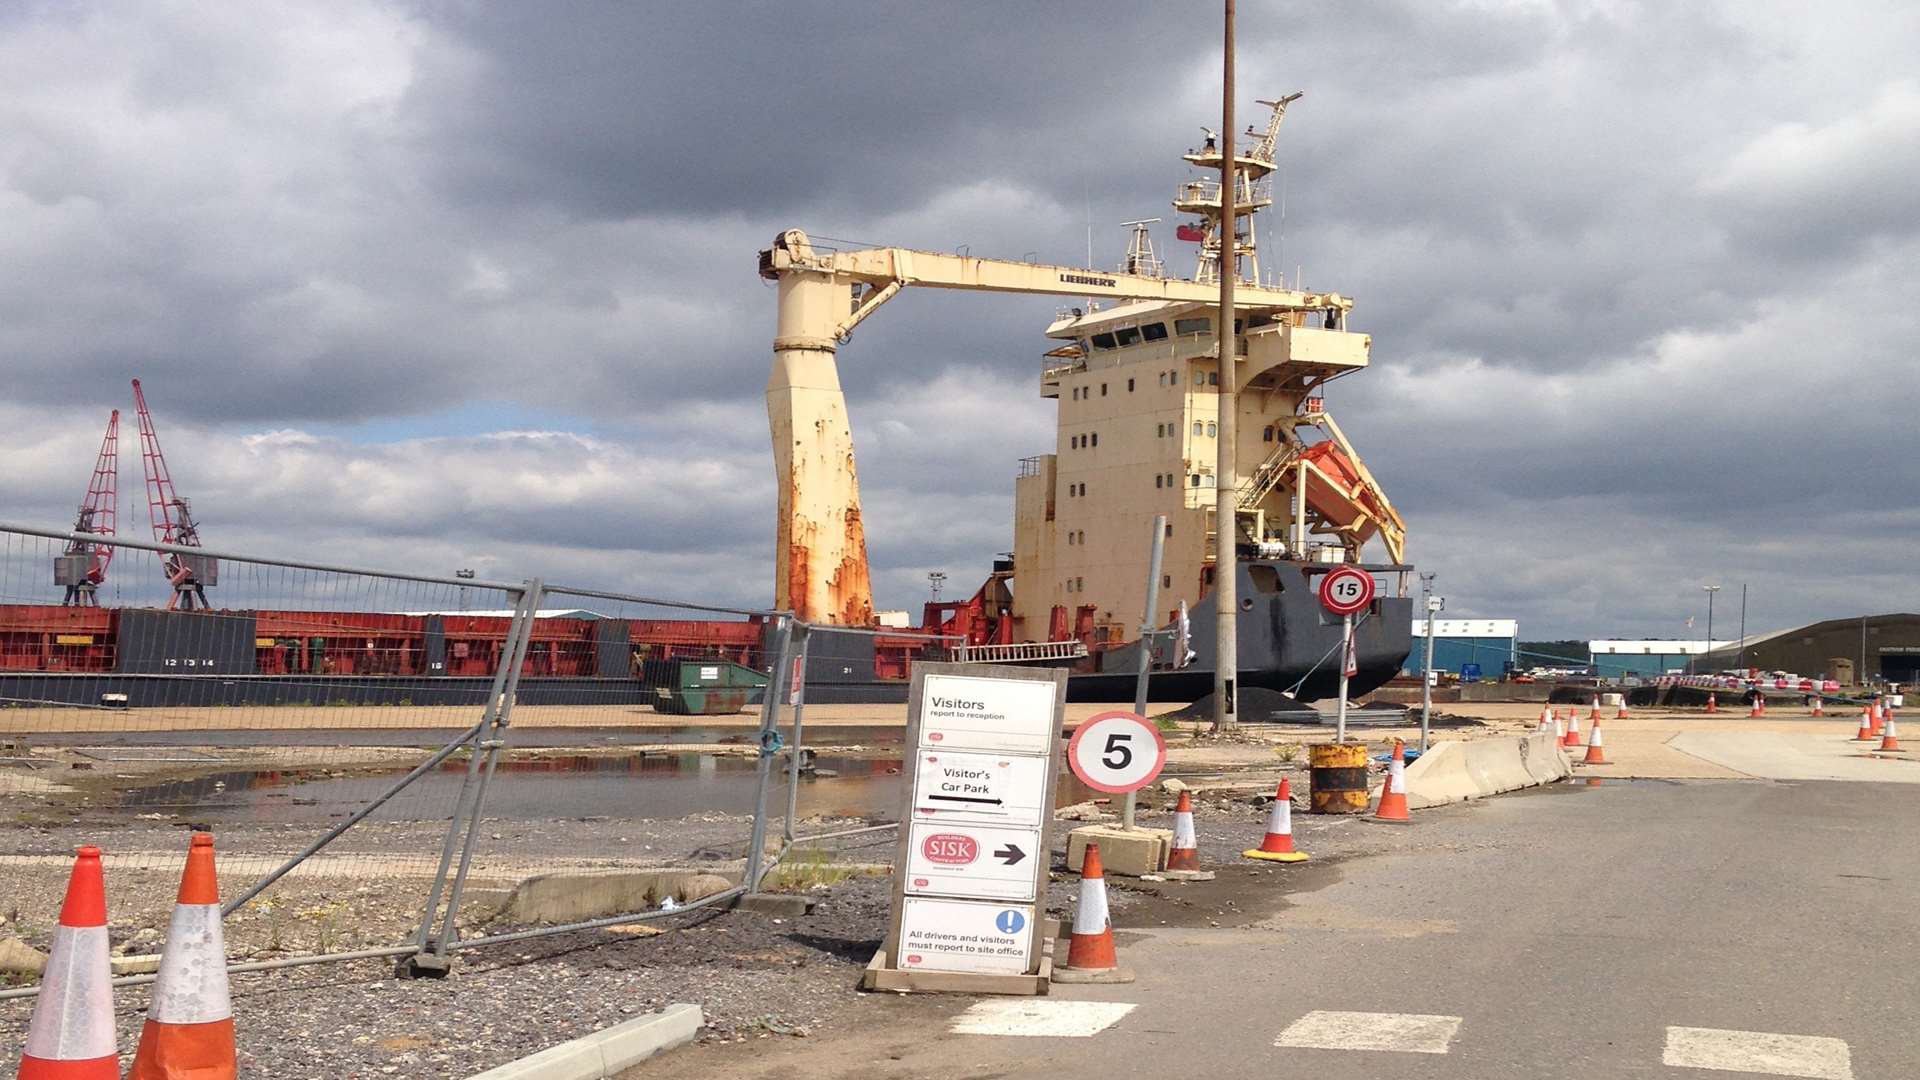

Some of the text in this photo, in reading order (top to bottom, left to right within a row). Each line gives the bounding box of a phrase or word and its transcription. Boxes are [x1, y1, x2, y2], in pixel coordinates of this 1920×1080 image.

[1060, 274, 1116, 288] LIEBHERR
[1337, 583, 1357, 596] 15
[931, 696, 985, 710] Visitors
[930, 710, 955, 718] report
[966, 712, 1005, 720] reception
[1102, 734, 1132, 770] 5
[943, 768, 991, 780] Visitor's
[941, 782, 990, 794] Car Park
[929, 840, 971, 857] SISK
[909, 930, 1015, 945] All drivers and visitors
[908, 941, 1024, 956] must report to site office
